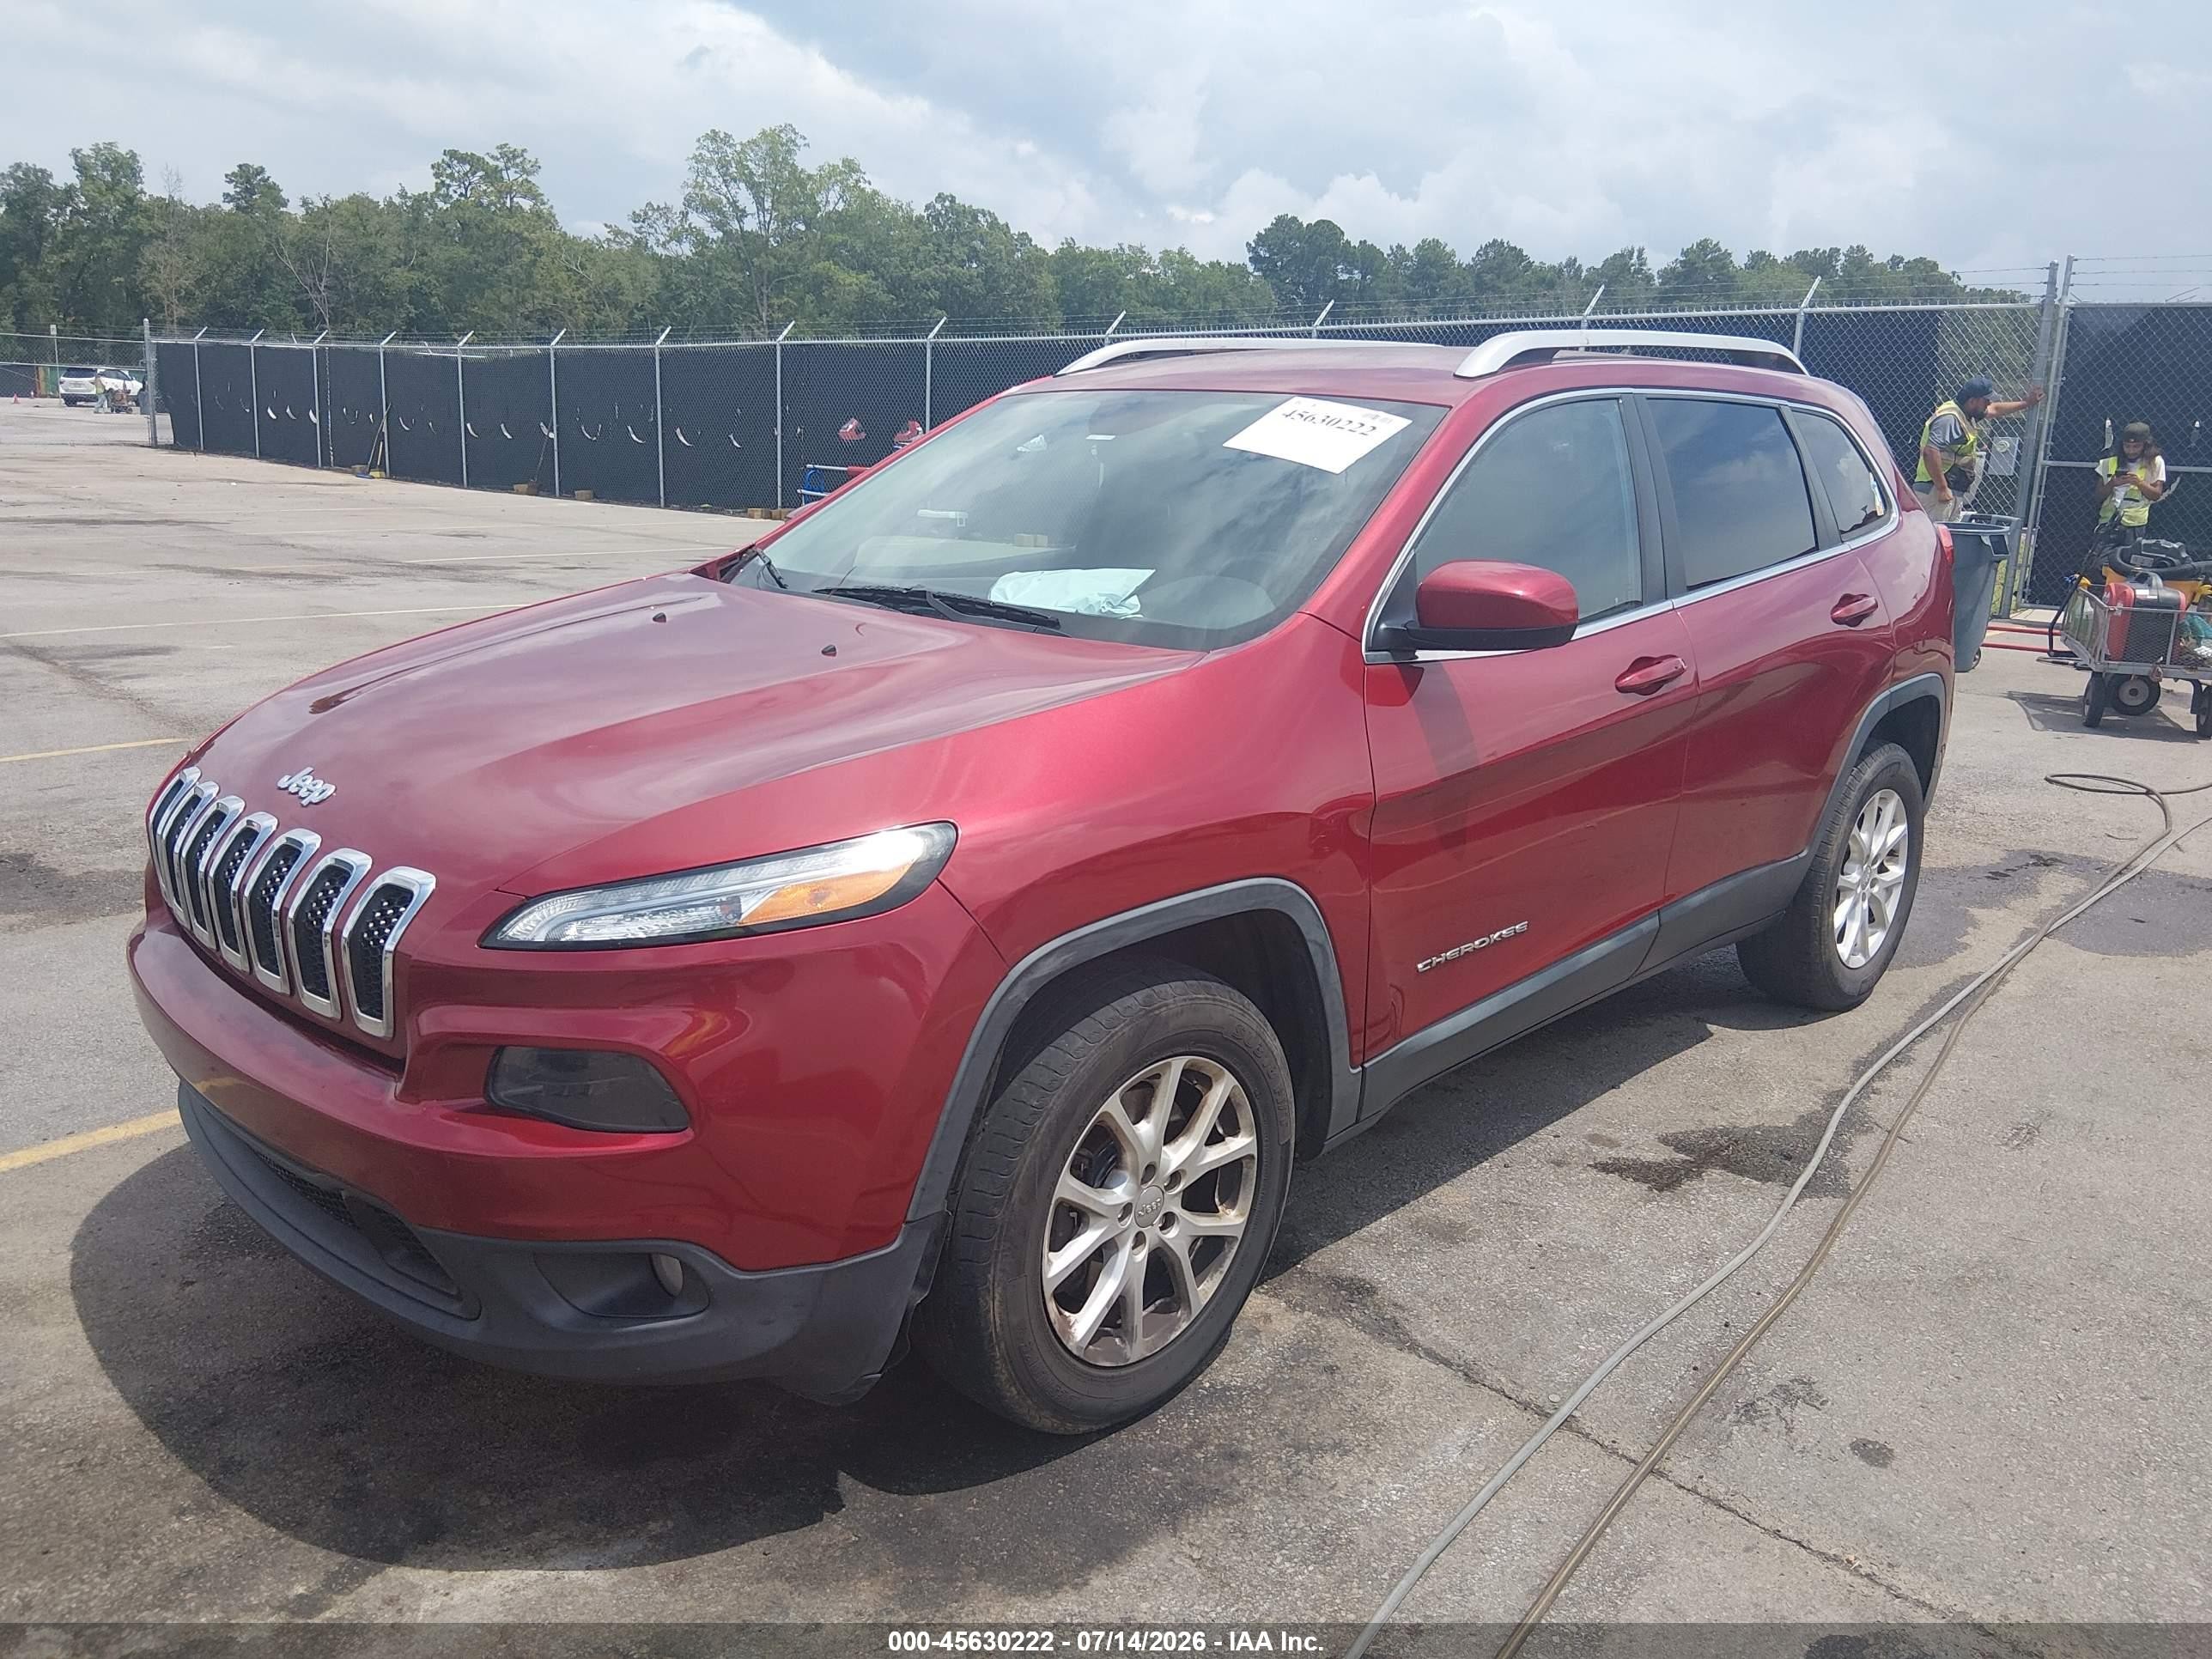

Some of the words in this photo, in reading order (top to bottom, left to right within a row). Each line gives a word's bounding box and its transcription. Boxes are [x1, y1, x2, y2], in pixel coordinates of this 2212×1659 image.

[1282, 409, 1376, 436] 45630222
[277, 766, 336, 806] Jeep
[1417, 921, 1528, 972] CHEROKEE
